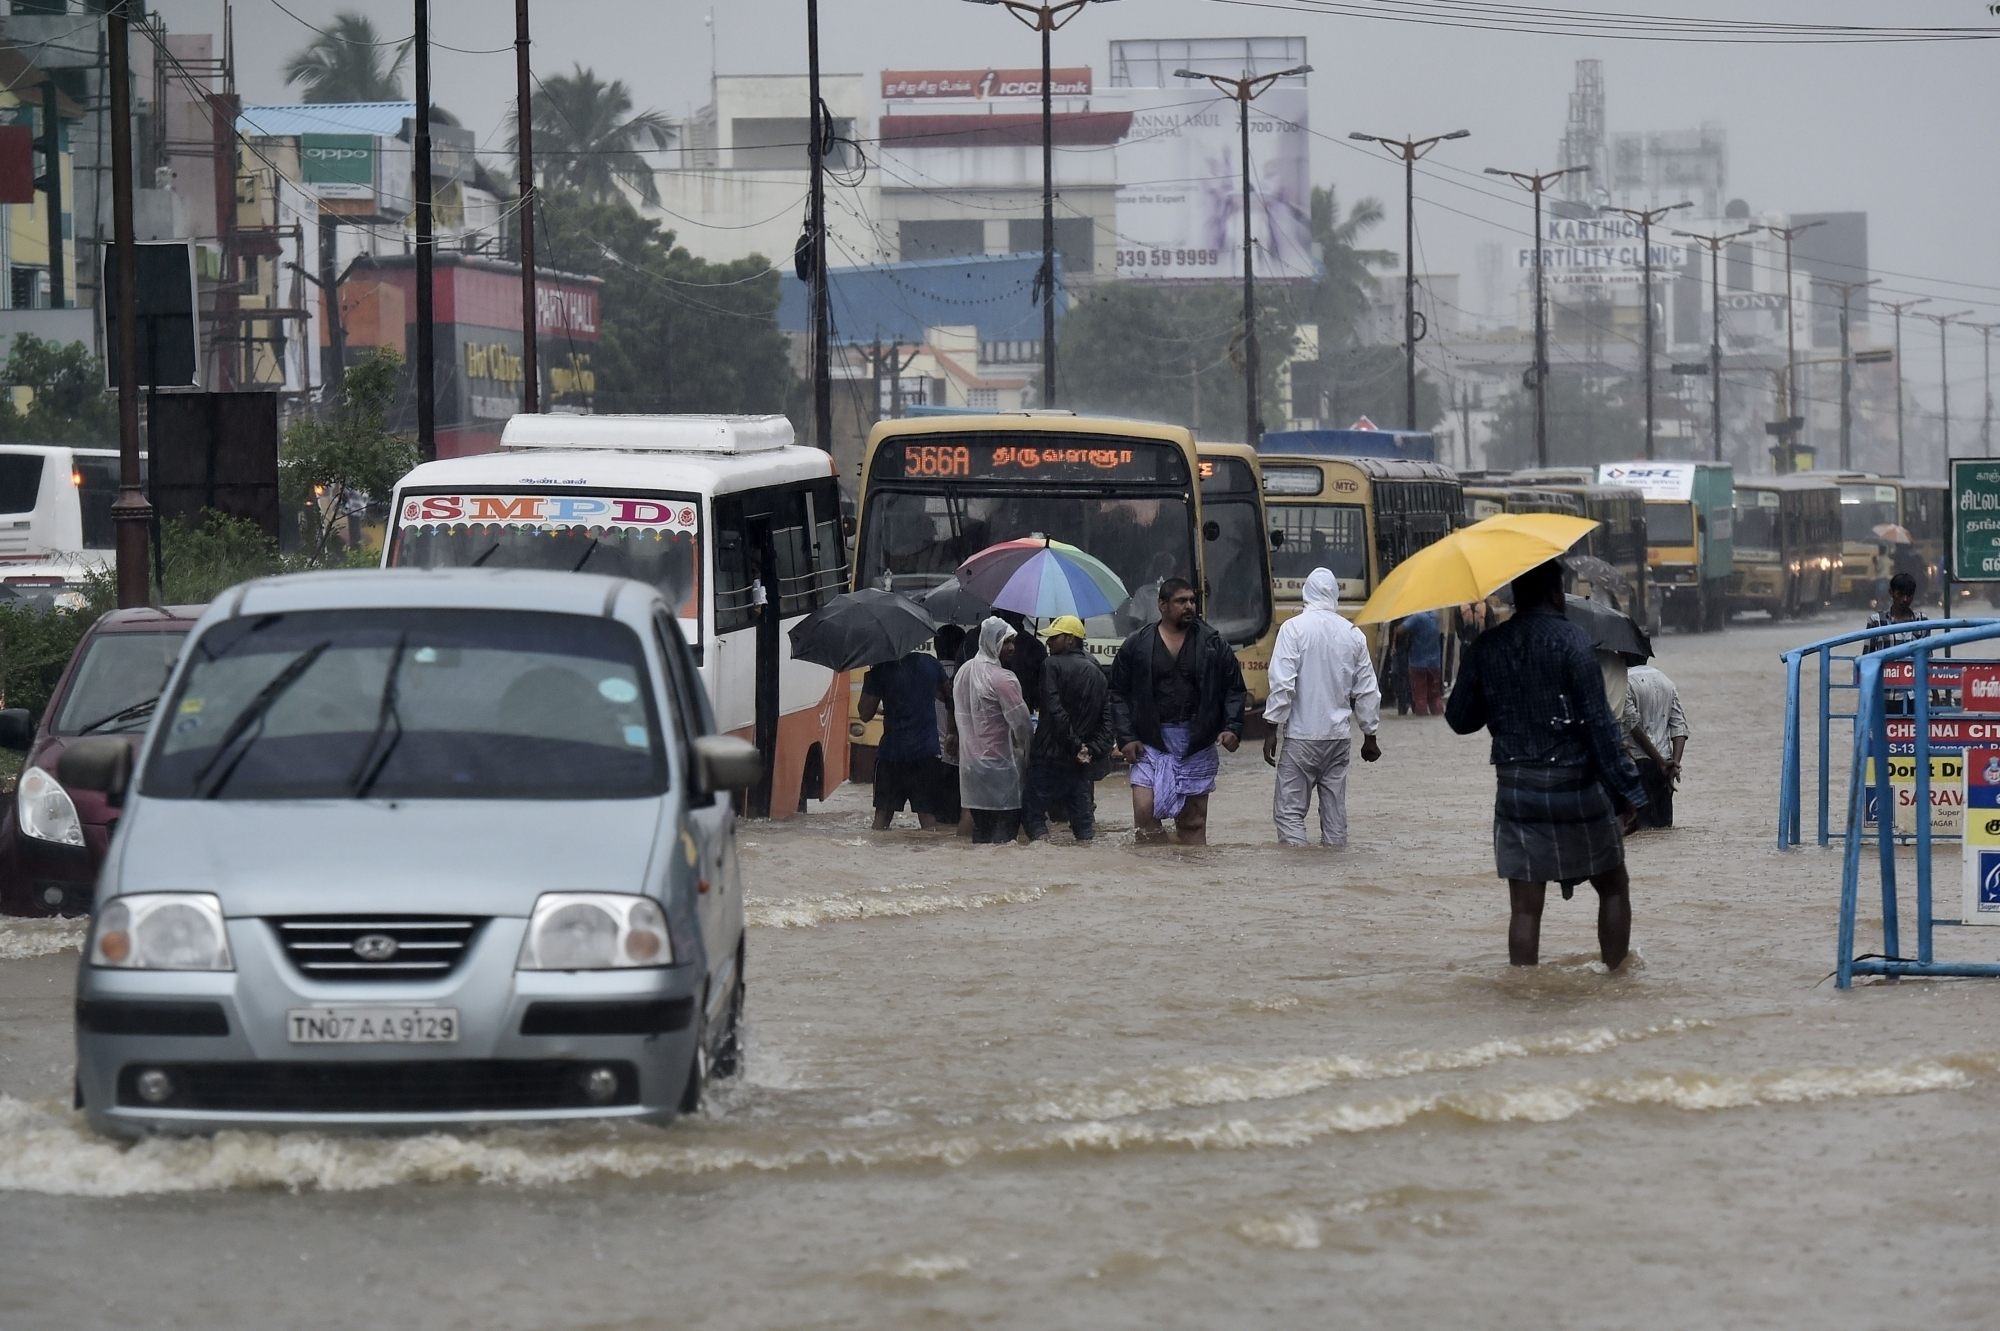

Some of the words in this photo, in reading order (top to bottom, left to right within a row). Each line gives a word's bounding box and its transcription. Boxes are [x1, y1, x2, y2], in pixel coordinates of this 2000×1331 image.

[1000, 83, 1041, 94] ICICI
[1182, 114, 1221, 127] ARUL
[1276, 122, 1299, 133] 700
[1156, 195, 1185, 205] Expert
[1116, 250, 1147, 267] 939
[1151, 250, 1172, 266] 59
[1176, 249, 1218, 266] 9999
[1619, 247, 1681, 265] CLNIC
[1719, 295, 1783, 309] SONY
[569, 291, 596, 333] HALL
[904, 446, 970, 476] 566A
[1335, 481, 1357, 492] MTC
[1886, 723, 1959, 738] CHENAI
[1888, 743, 1915, 754] S-13
[1937, 808, 1961, 817] Super
